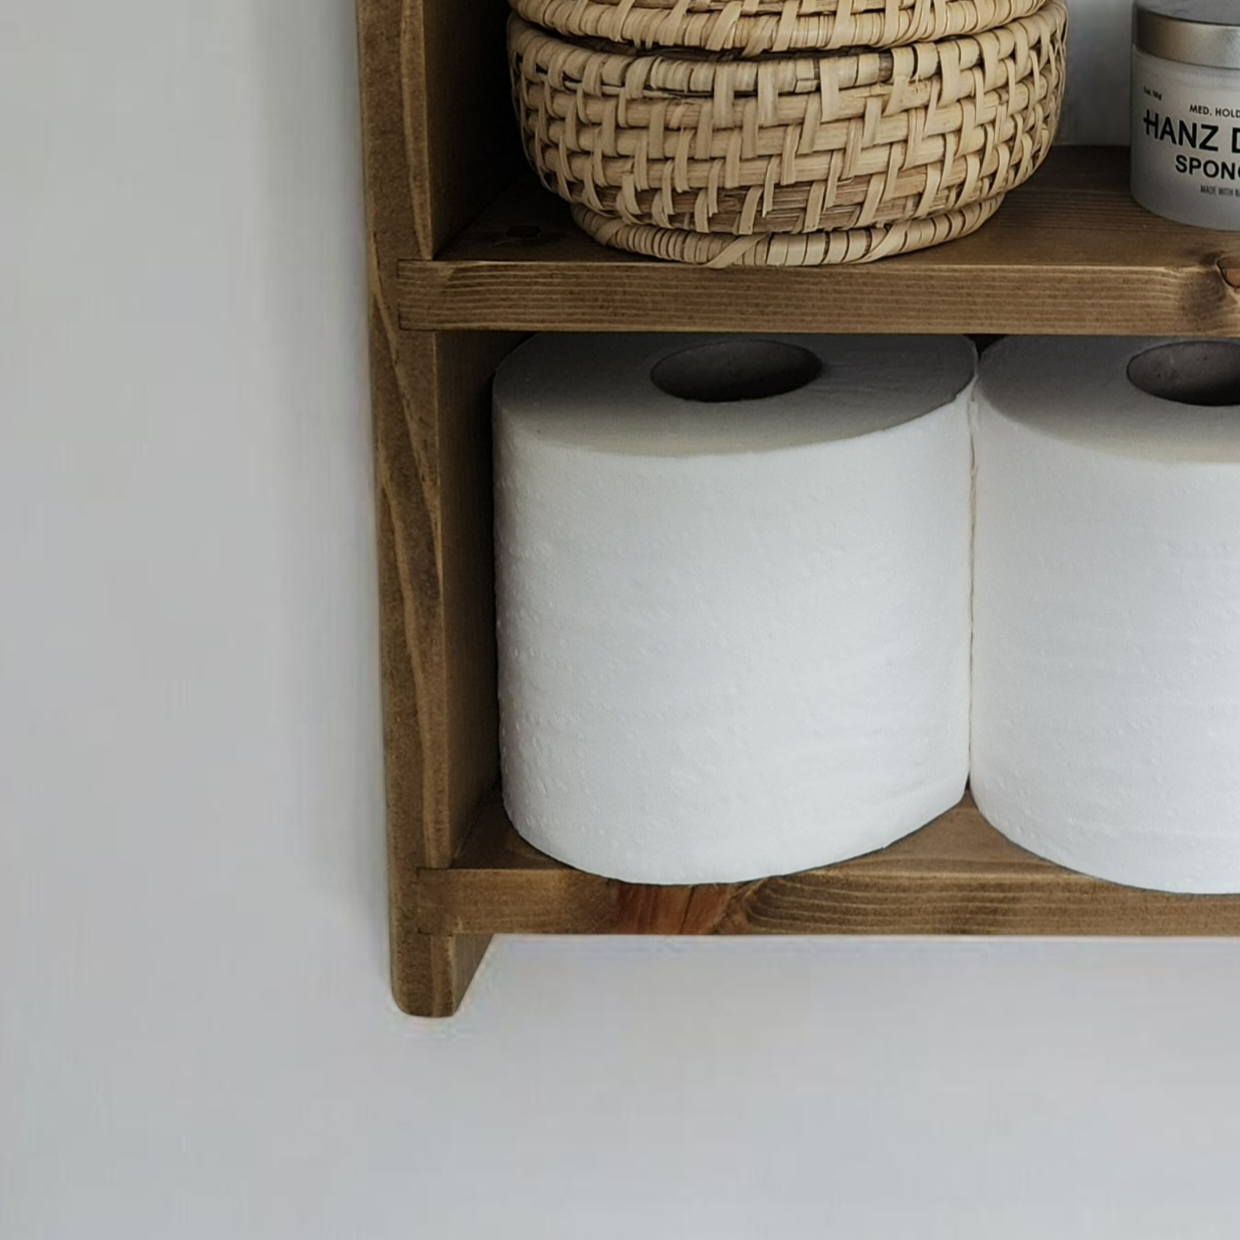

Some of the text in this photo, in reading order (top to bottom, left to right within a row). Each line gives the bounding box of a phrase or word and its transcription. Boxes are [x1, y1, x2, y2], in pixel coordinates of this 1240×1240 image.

[1189, 104, 1213, 117] MED.
[1143, 109, 1219, 152] HANZ
[1200, 184, 1217, 196] MADE
[1218, 187, 1234, 197] WITH
